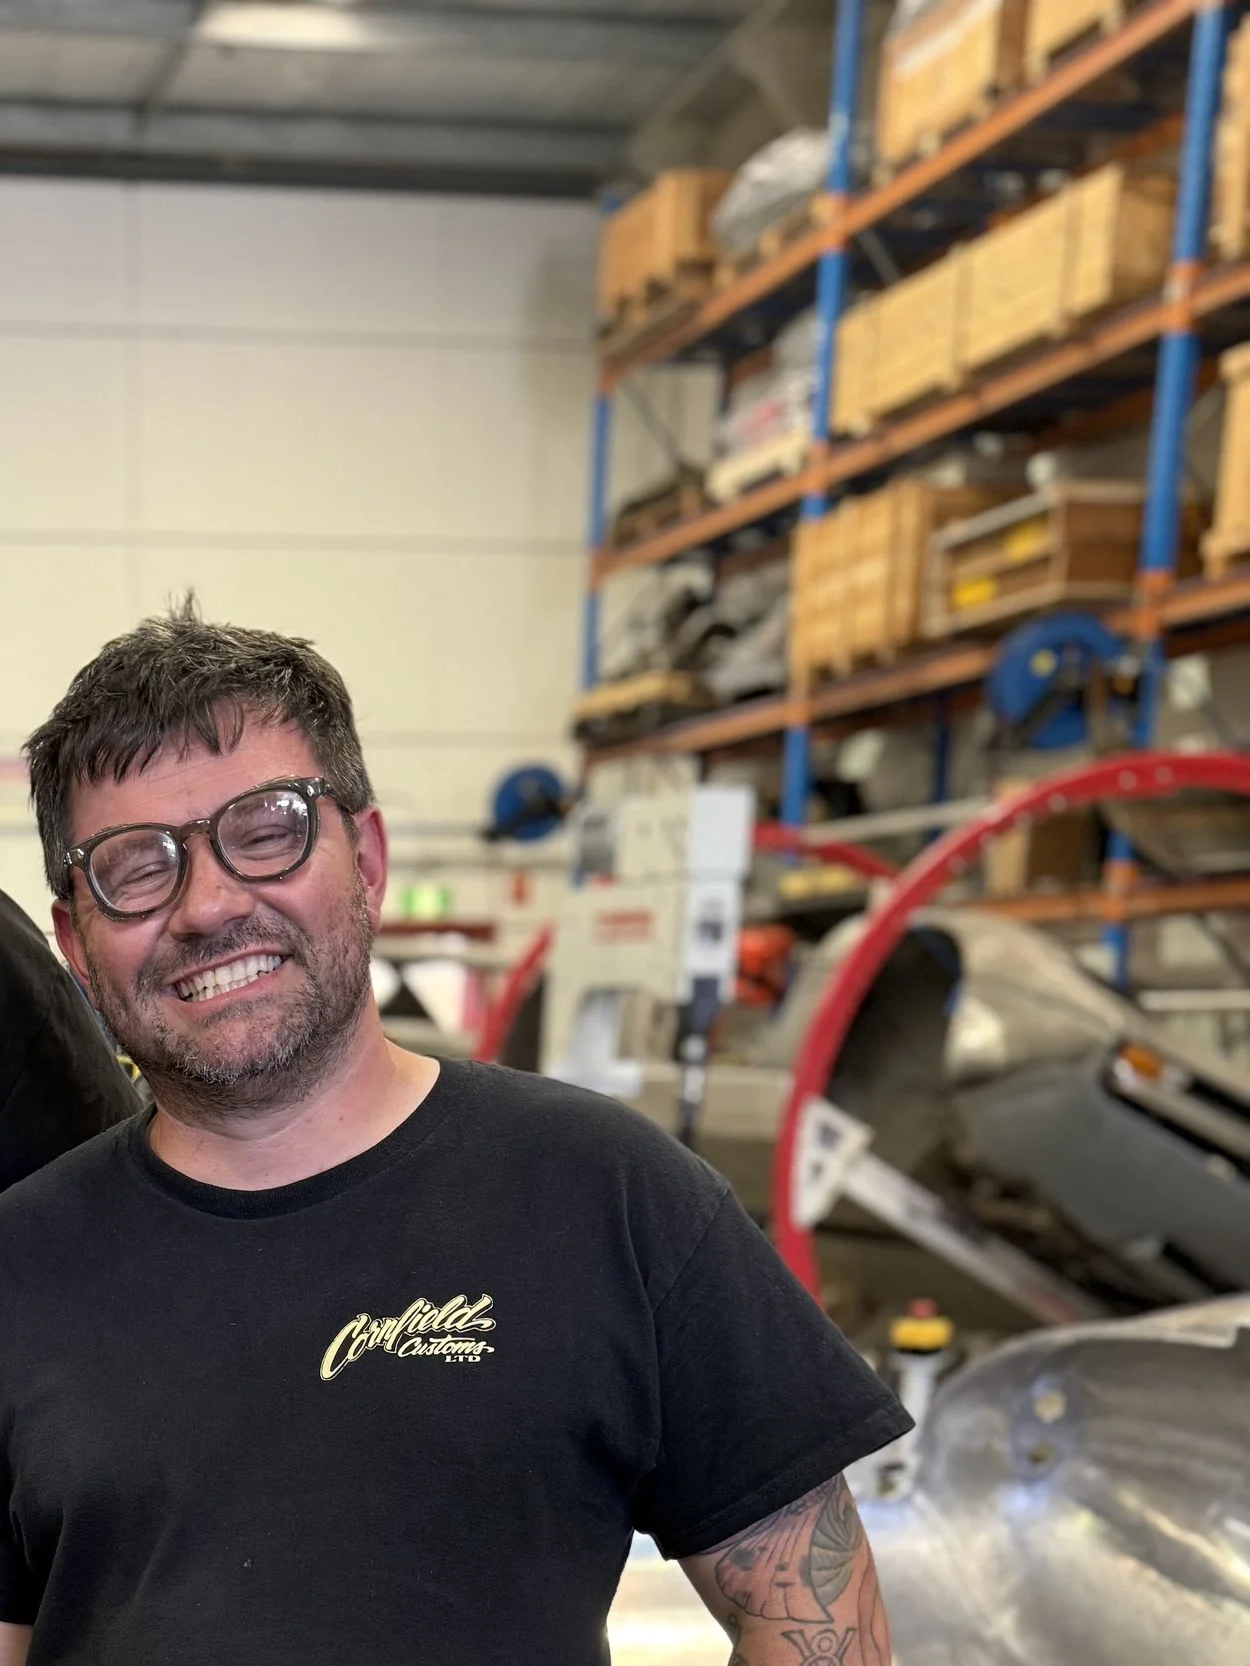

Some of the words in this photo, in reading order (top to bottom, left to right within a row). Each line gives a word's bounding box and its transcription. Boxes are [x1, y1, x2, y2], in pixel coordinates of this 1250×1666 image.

[320, 1293, 497, 1381] Cornfield
[397, 1334, 495, 1358] Customs
[445, 1355, 482, 1363] LTD
